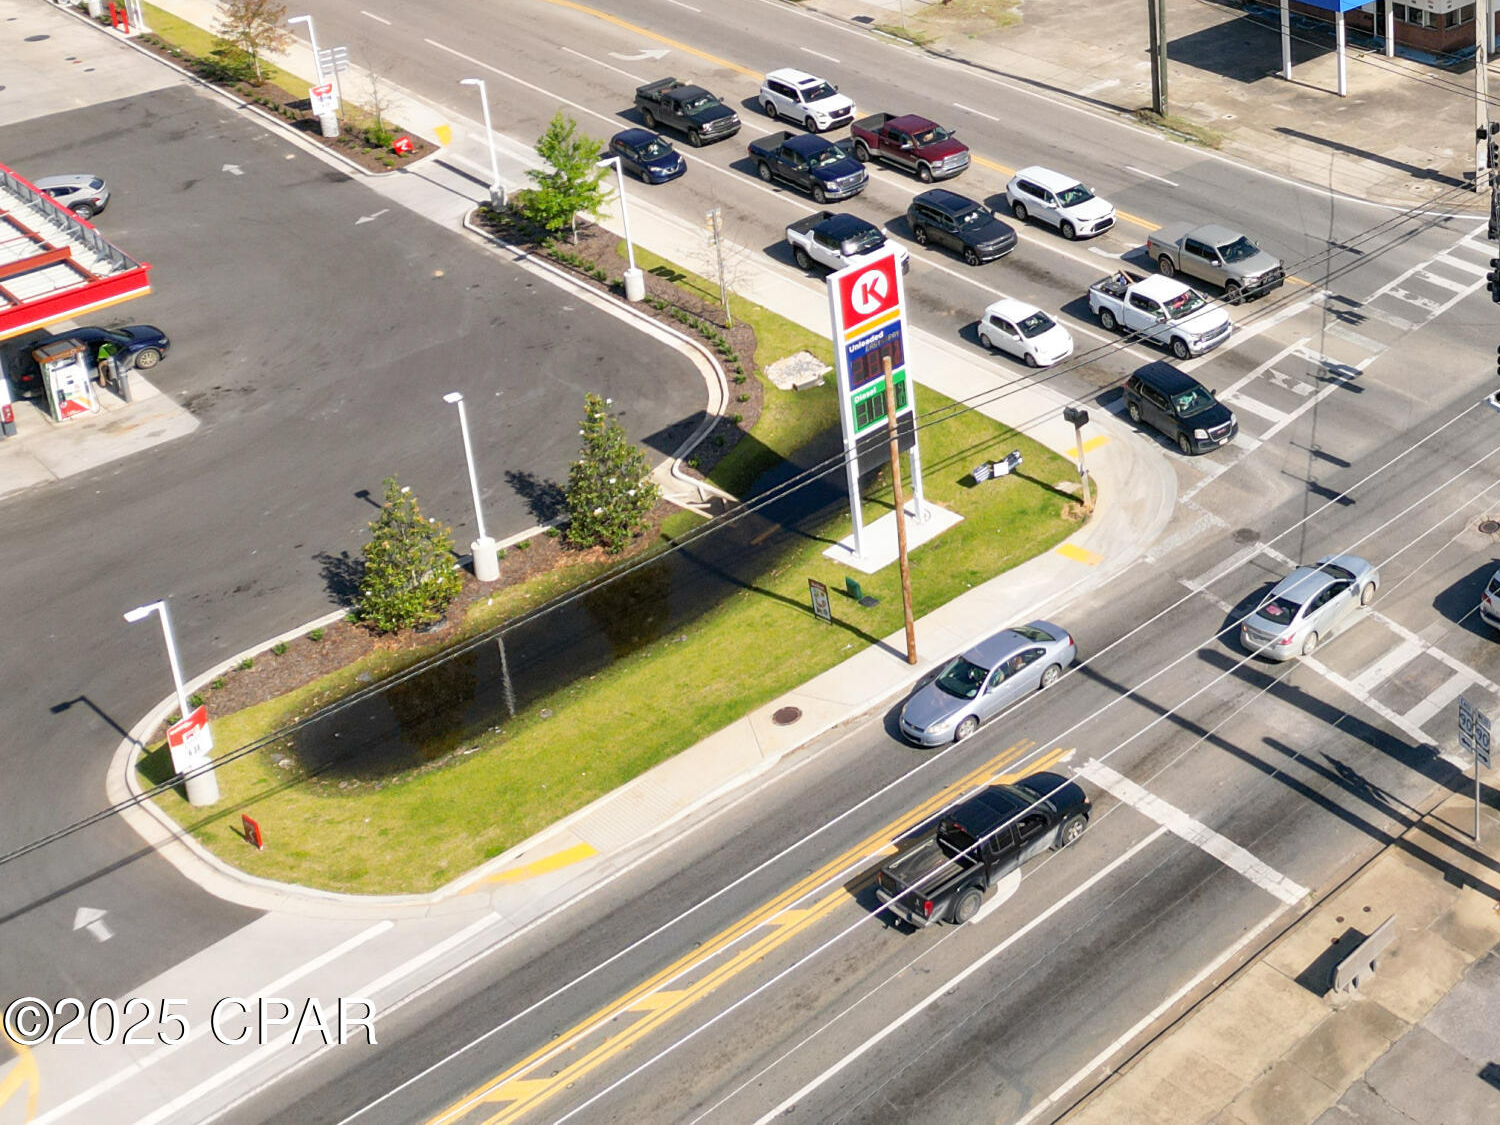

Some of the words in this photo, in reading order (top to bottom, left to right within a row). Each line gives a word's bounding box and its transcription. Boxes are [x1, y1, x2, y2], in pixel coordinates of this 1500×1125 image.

[861, 275, 886, 306] K
[848, 331, 884, 353] Unleaded
[854, 386, 877, 404] Diesel
[1460, 713, 1472, 733] 90
[1476, 728, 1489, 748] 90
